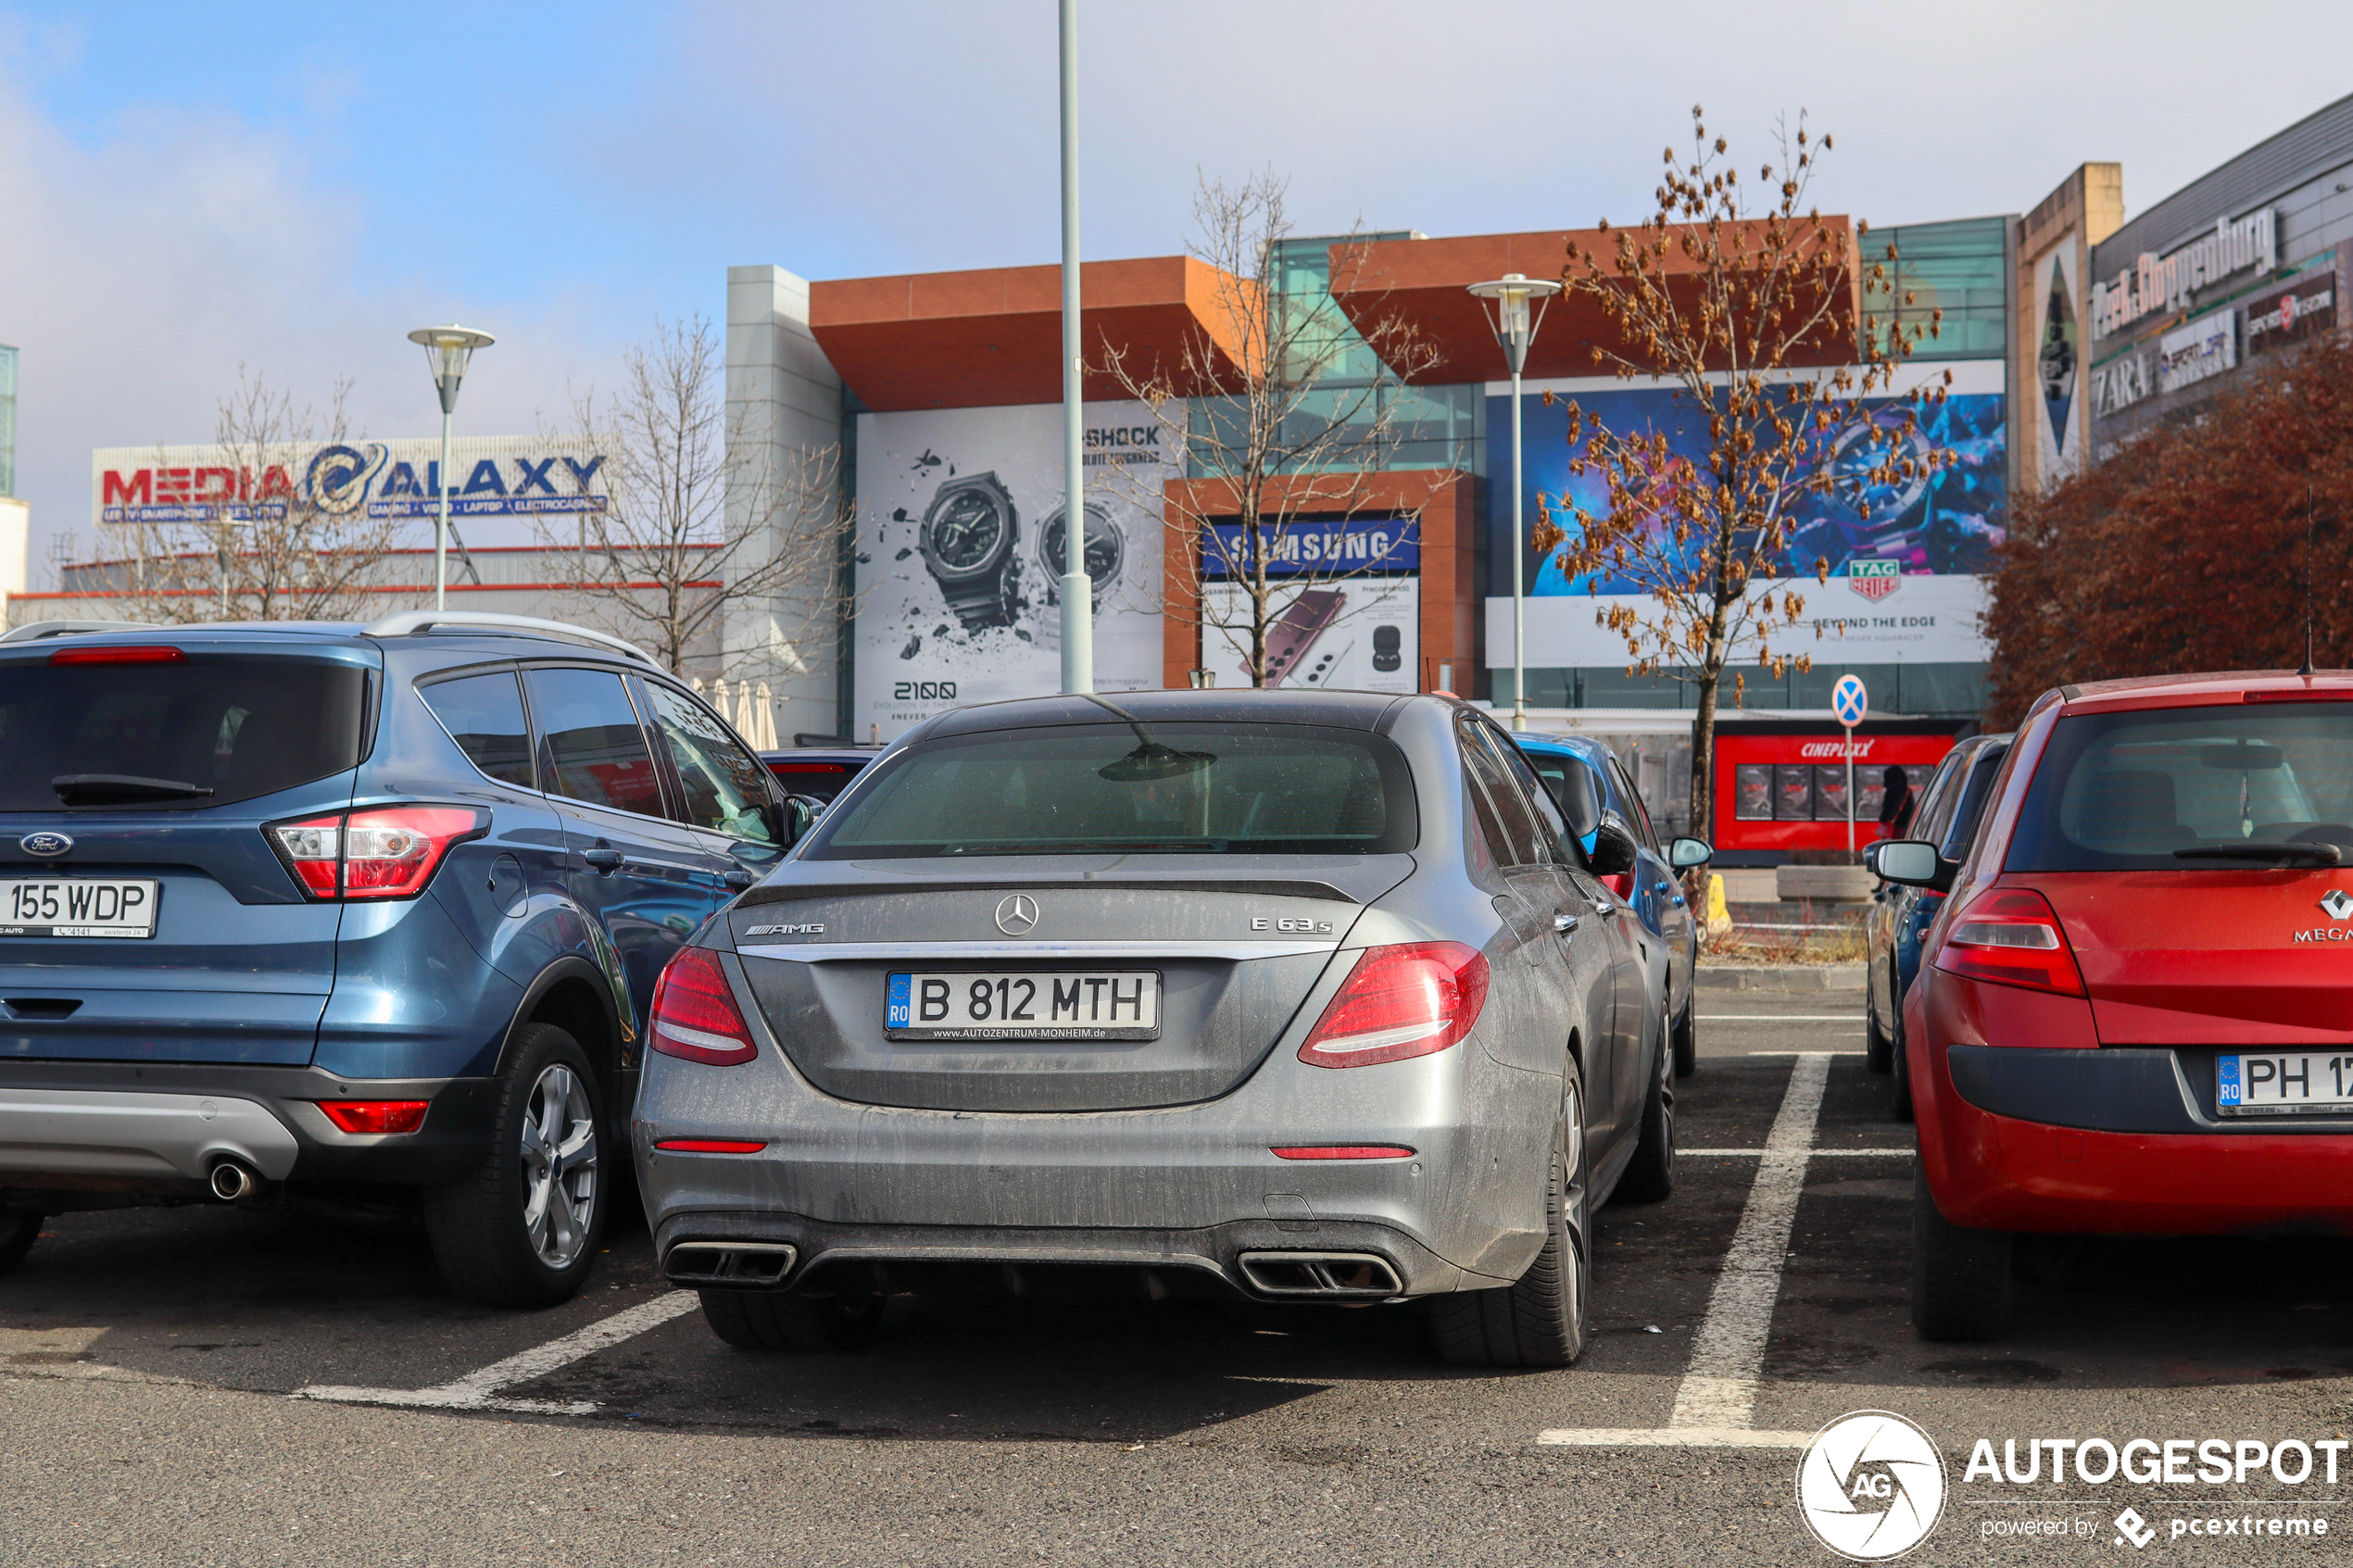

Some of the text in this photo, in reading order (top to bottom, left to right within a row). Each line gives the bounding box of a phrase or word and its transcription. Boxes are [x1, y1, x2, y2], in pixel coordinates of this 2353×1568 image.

[2095, 352, 2151, 419] ZARA
[103, 465, 293, 505] MEDIA
[463, 500, 503, 513] LAPTOP
[1231, 531, 1390, 562] SAMSUNG
[1854, 562, 1895, 576] TAG
[1853, 578, 1898, 598] HEUER
[1813, 616, 1936, 629] BEYOND THE EDGE
[894, 682, 957, 700] 2100
[31, 836, 58, 850] Ford
[11, 884, 145, 921] 155 WDP
[768, 923, 824, 935] AMG
[1251, 917, 1269, 931] E
[919, 978, 1143, 1022] B 812 MTH
[890, 1005, 909, 1022] RO
[933, 1028, 1106, 1038] www.AUTOZENTRUM-MONHEIM.de
[2246, 1059, 2310, 1099] PH
[2221, 1084, 2240, 1100] RO
